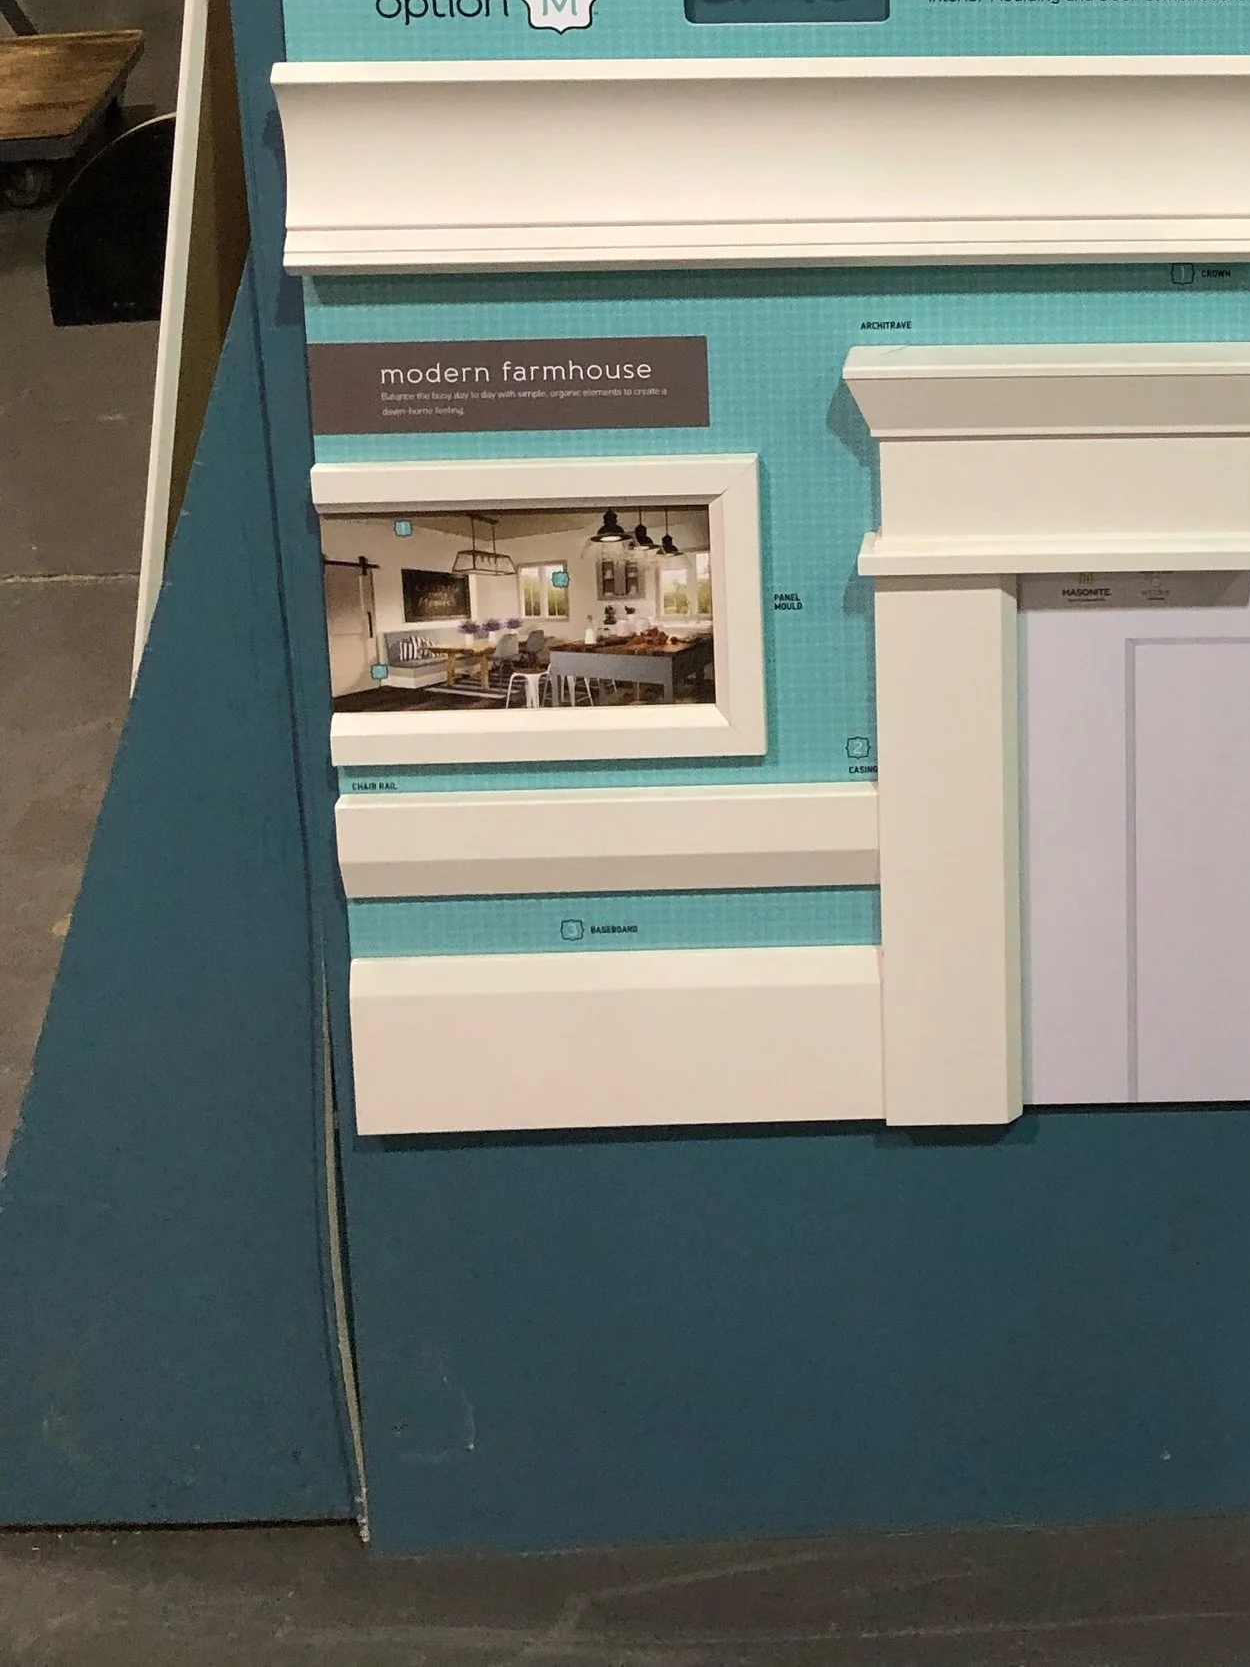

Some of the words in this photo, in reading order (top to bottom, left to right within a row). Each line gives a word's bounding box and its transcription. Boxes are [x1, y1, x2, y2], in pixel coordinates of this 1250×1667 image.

[1201, 269, 1232, 279] CROWN
[860, 320, 912, 330] ARCHITRAVE
[381, 362, 490, 384] modern
[502, 360, 652, 383] farmhouse
[381, 392, 415, 401] Balance
[417, 392, 430, 400] the
[432, 391, 453, 401] busy
[454, 391, 469, 401] day
[470, 391, 480, 399] to
[481, 390, 496, 400] day
[497, 390, 516, 399] with
[550, 389, 580, 400] organic
[582, 387, 622, 397] elements
[624, 388, 633, 396] to
[634, 387, 660, 396] create
[661, 388, 668, 396] a
[774, 593, 801, 602] PANEL
[1062, 588, 1111, 597] MASONITE
[774, 601, 803, 611] MOULD
[853, 742, 863, 755] 2
[849, 765, 878, 774] CASING
[352, 782, 377, 791] CHAIR
[378, 782, 398, 791] RAIL
[590, 925, 639, 935] BASEBOARD
